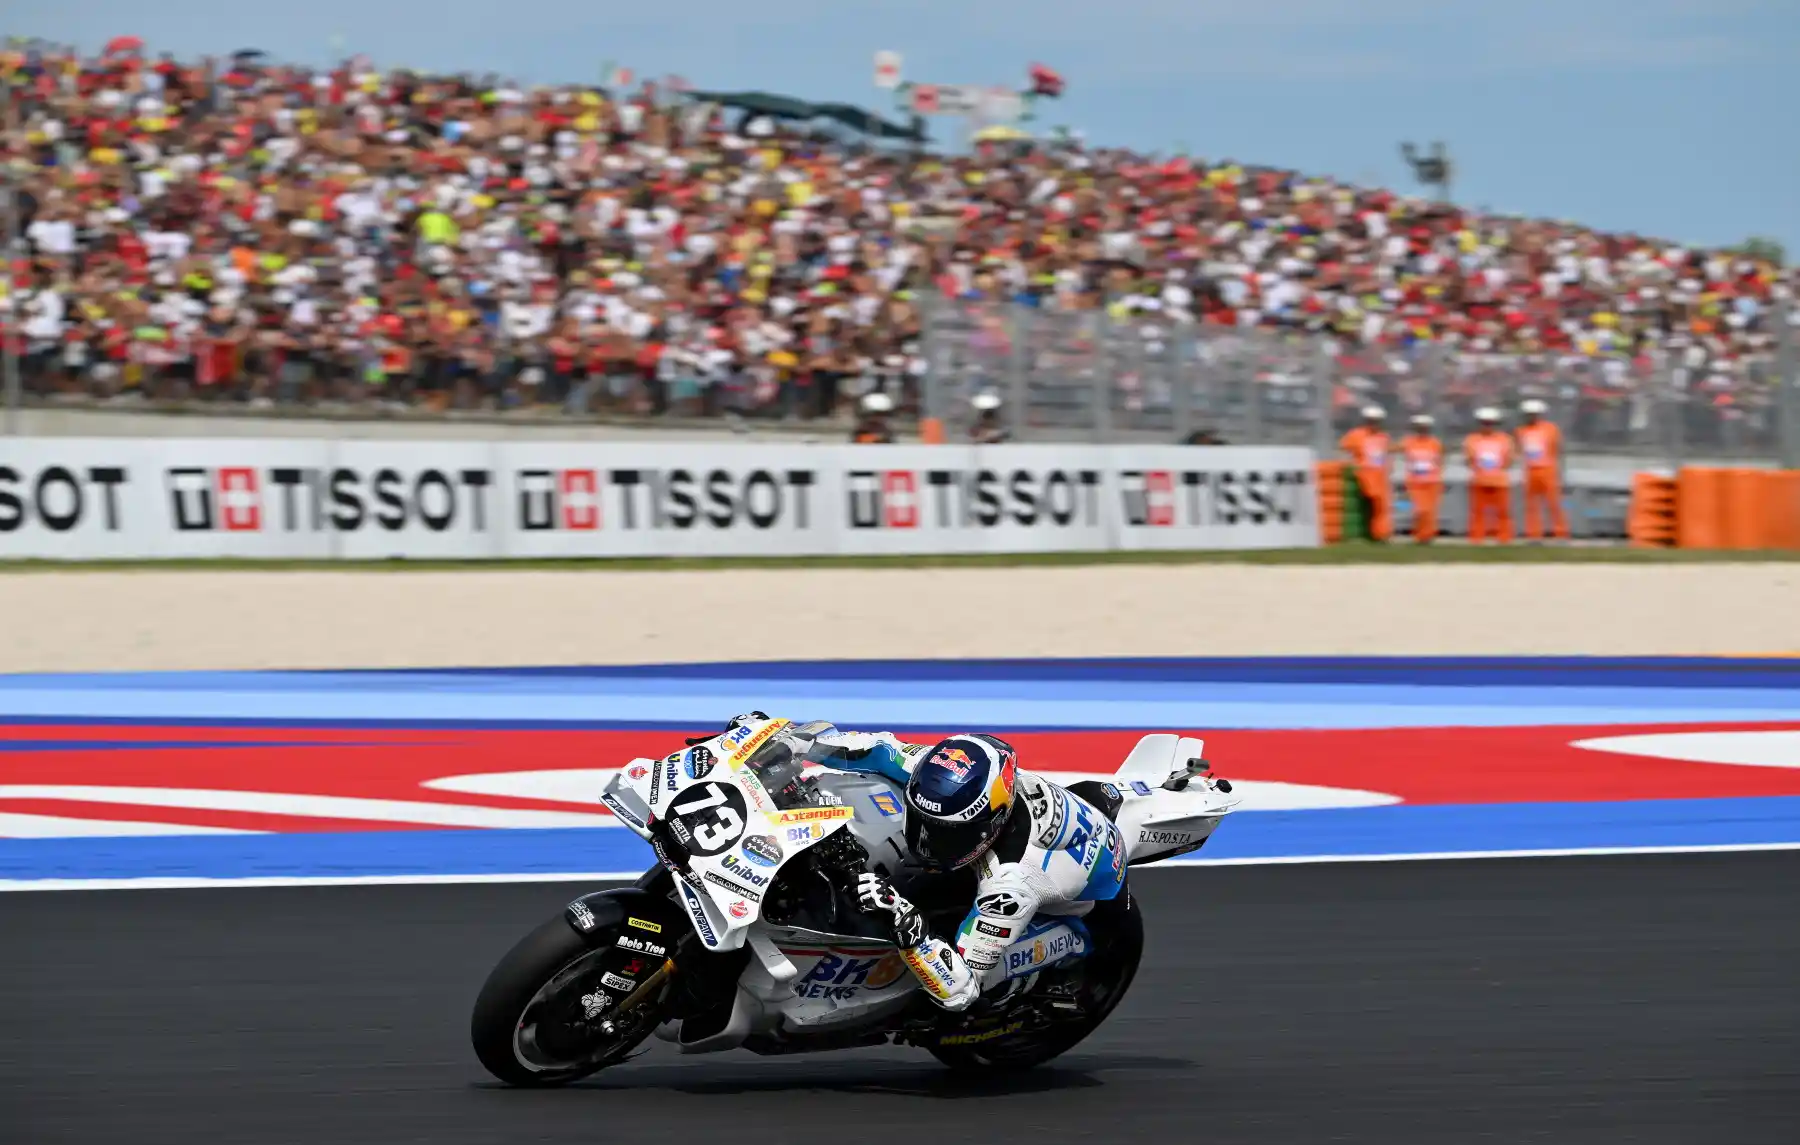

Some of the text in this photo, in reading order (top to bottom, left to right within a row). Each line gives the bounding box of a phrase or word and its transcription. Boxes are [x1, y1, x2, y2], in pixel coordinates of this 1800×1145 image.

[269, 467, 491, 531] TISSOT
[608, 468, 816, 530] TISSOT
[926, 469, 1102, 528] TISSOT
[667, 753, 681, 792] Unibat
[914, 793, 942, 813] SHOEI
[673, 782, 744, 851] 73
[721, 854, 770, 887] Unibat
[980, 923, 1001, 934] BOLD
[616, 935, 666, 955] Moto Tron
[1049, 931, 1082, 956] NEWS
[605, 979, 631, 991] SIPEX
[933, 961, 956, 987] NEWS
[795, 982, 862, 1000] NEWS
